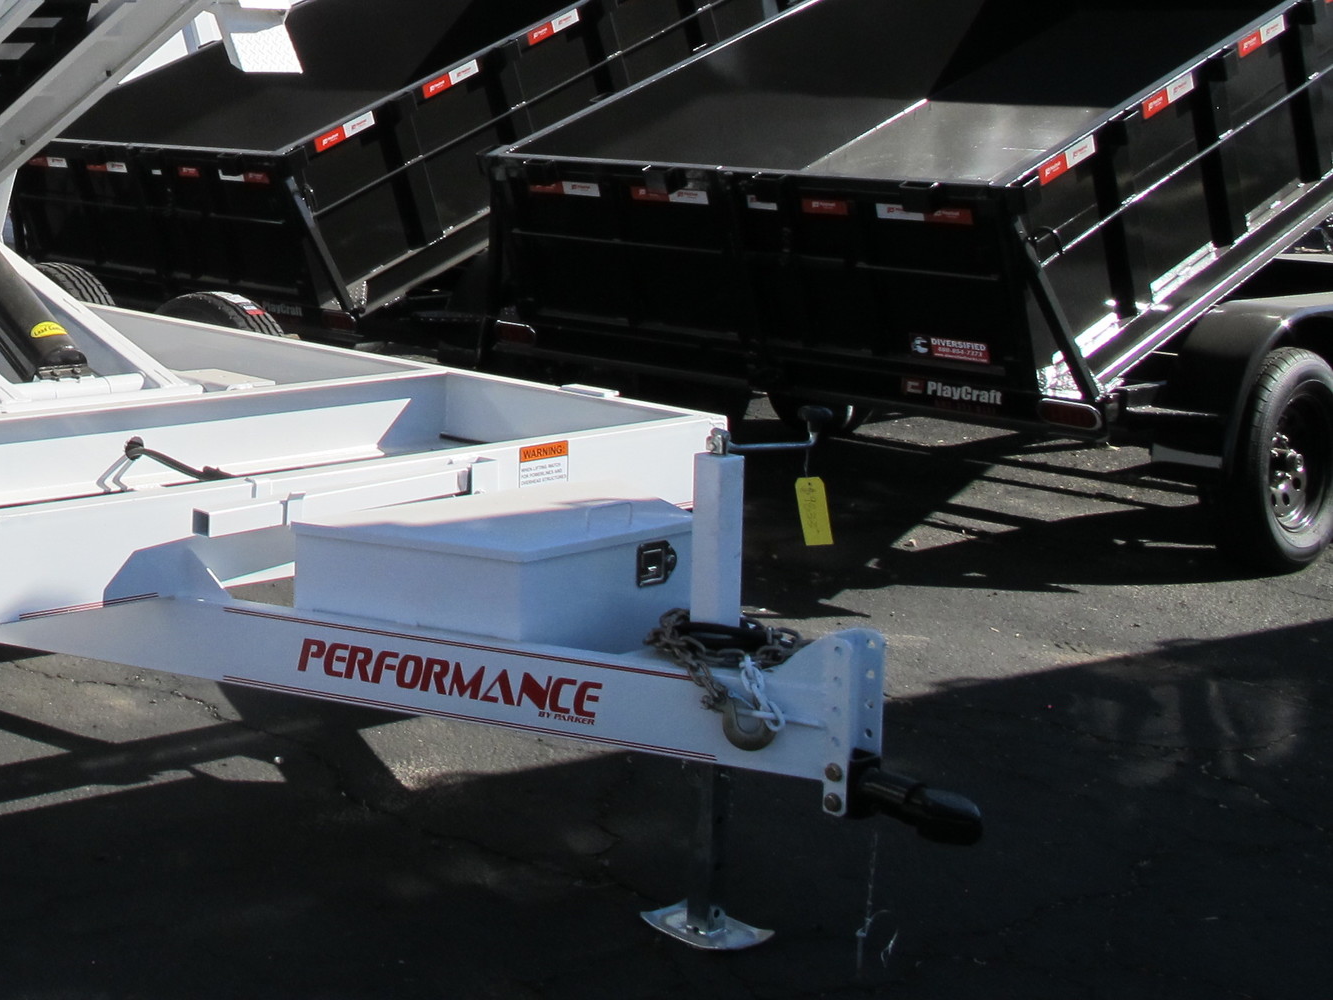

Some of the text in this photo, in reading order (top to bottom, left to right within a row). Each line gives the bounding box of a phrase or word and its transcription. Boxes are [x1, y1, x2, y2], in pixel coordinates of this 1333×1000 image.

[930, 337, 987, 352] DIVERSIFIED
[926, 381, 1002, 405] PlayCraft
[298, 638, 603, 719] PERFORMANCE
[538, 711, 595, 726] BY PARKER
